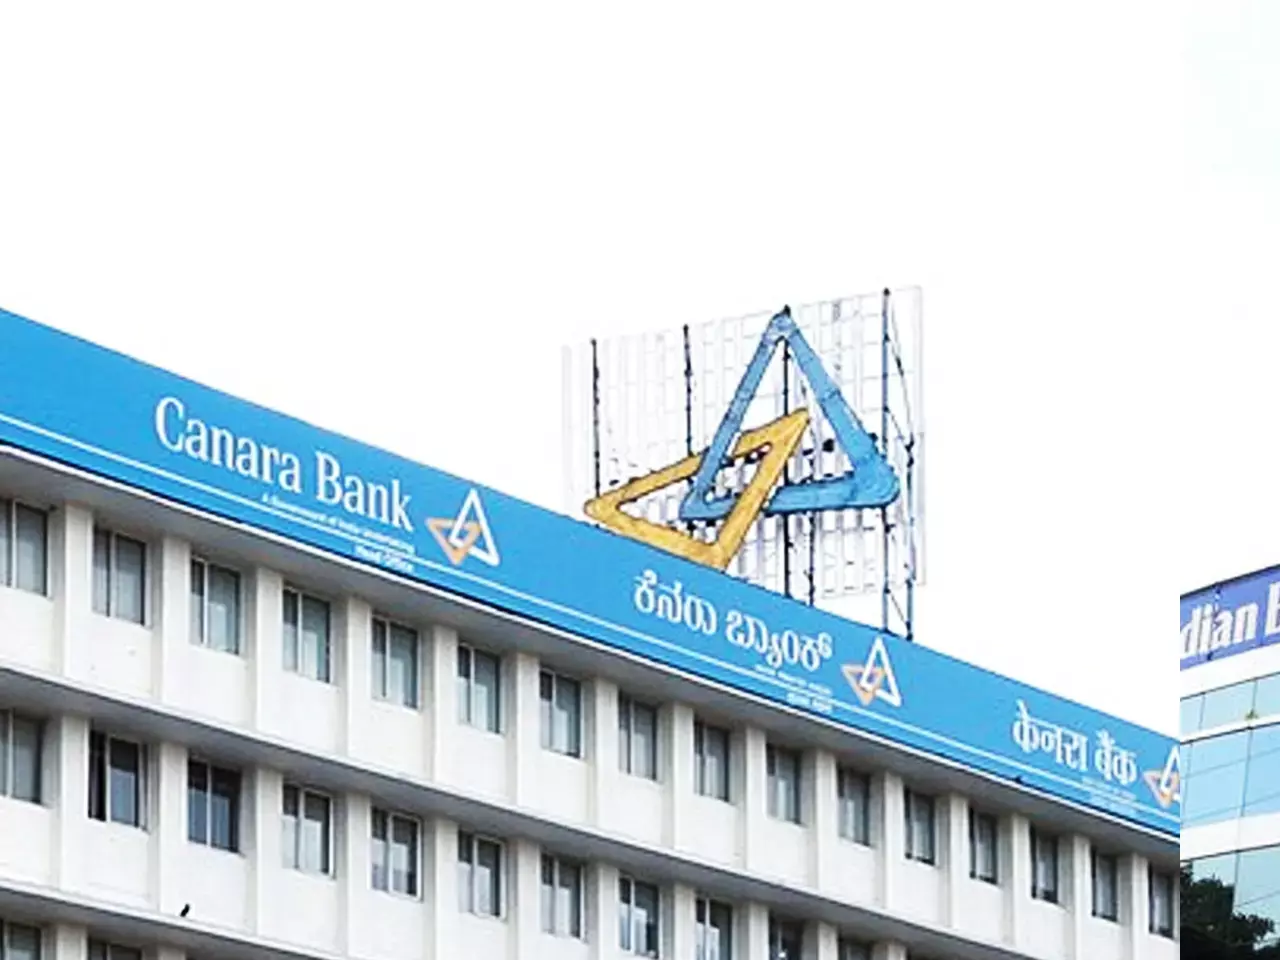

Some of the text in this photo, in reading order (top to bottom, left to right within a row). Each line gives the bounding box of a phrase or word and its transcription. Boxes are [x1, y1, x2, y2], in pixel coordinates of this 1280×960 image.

[154, 397, 414, 532] Canara Bank
[633, 569, 718, 636] ಕೆನರಾ
[1012, 699, 1138, 786] केनरा बैंक
